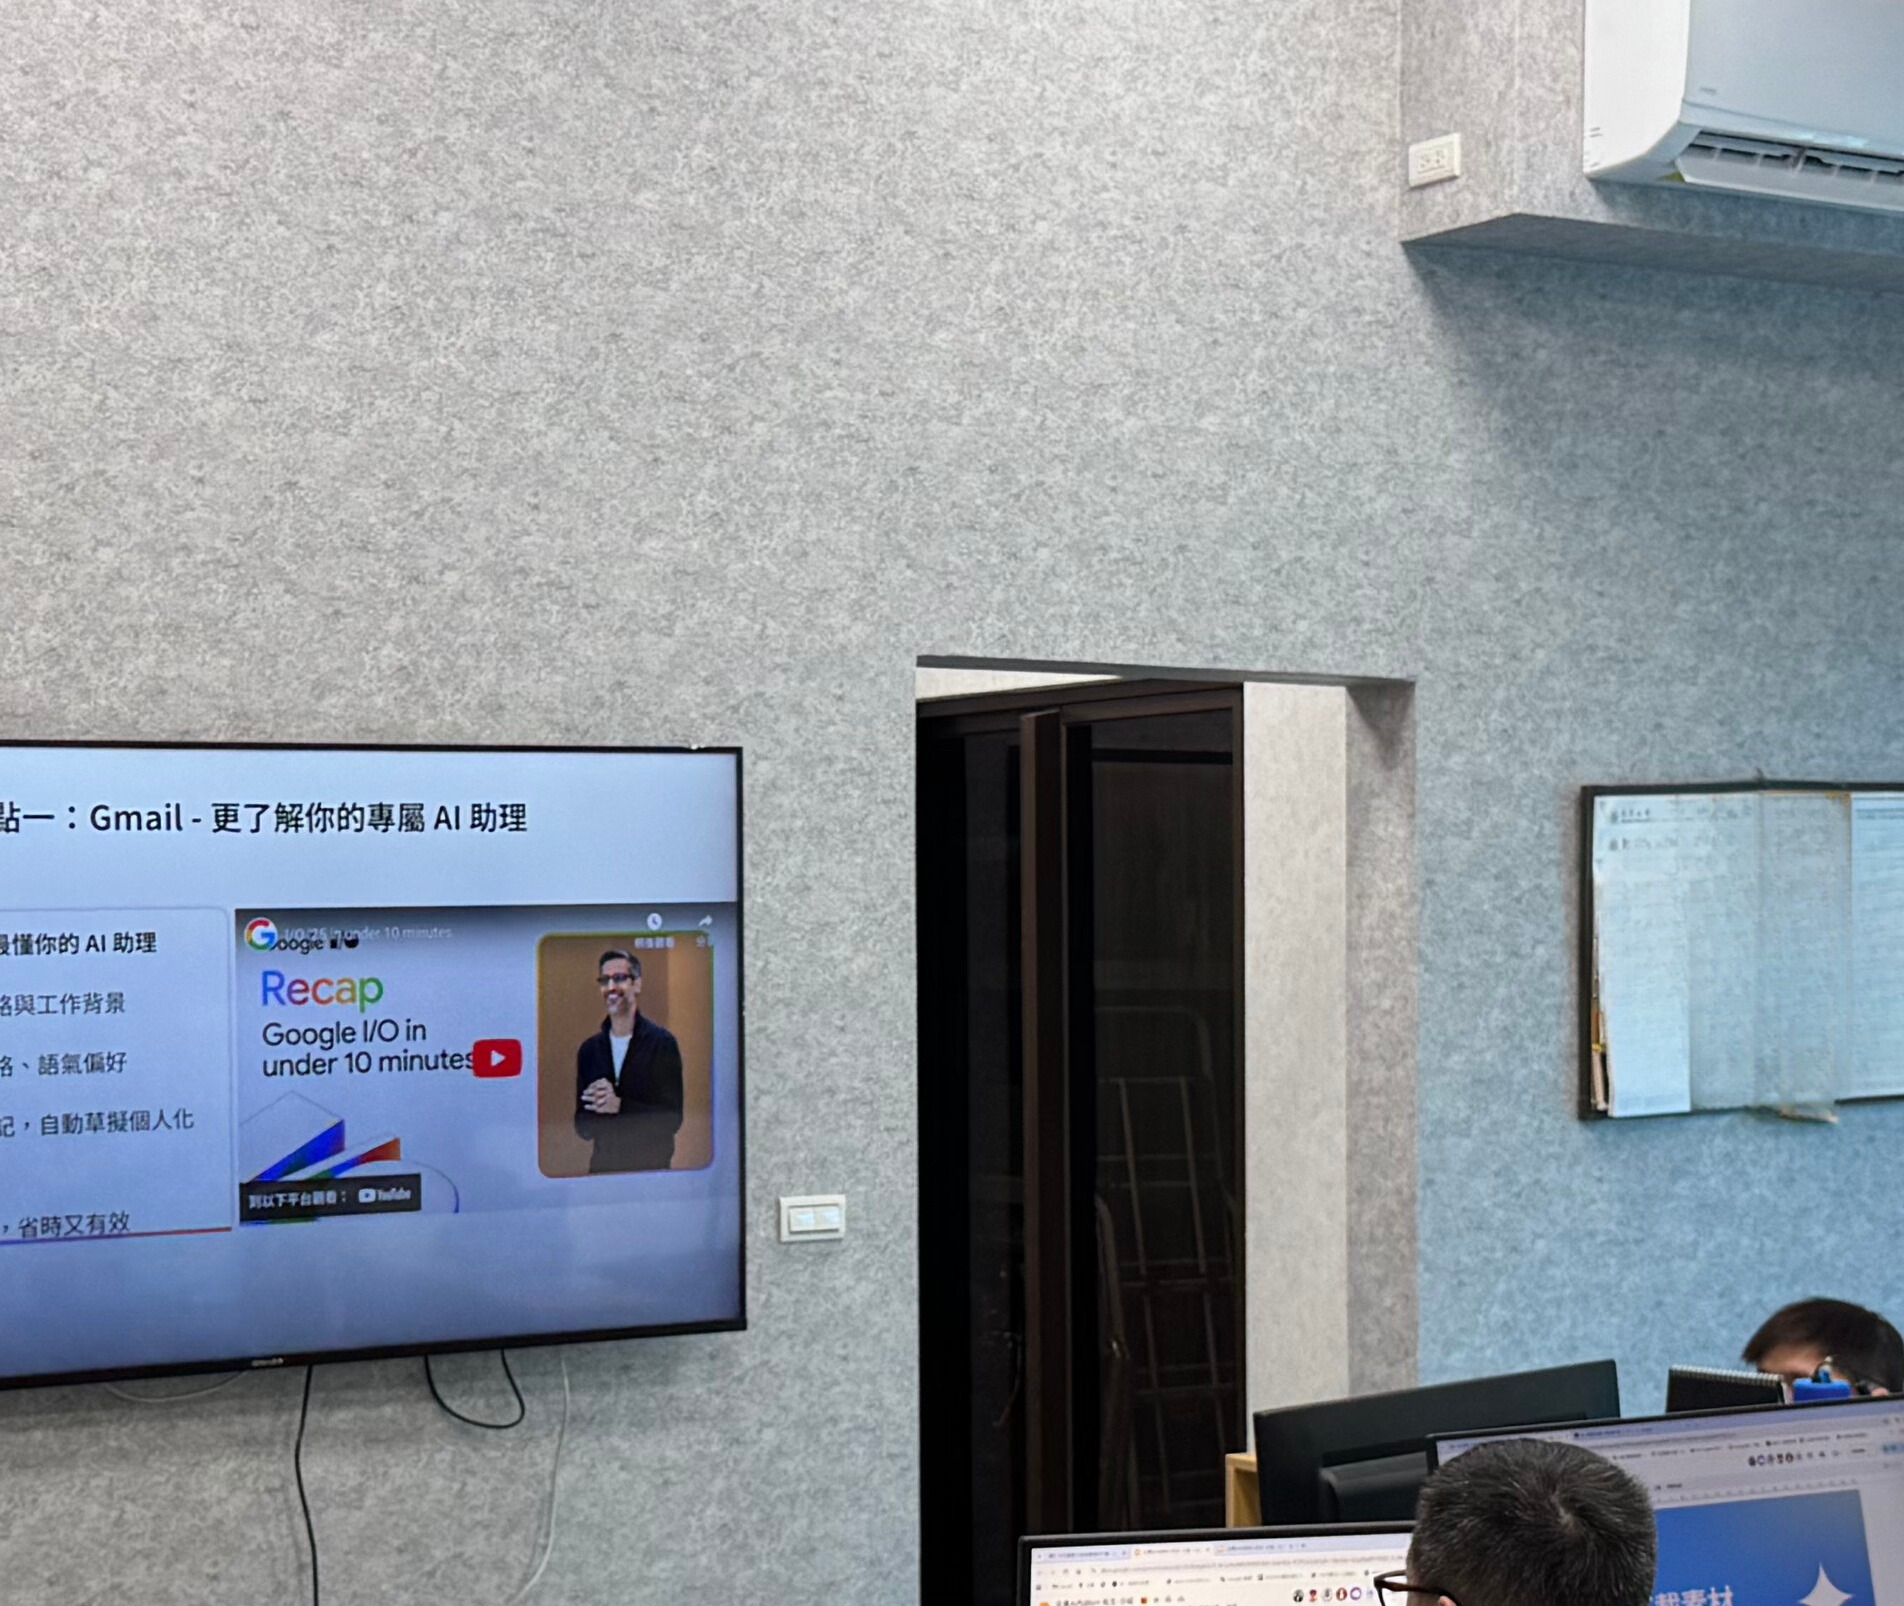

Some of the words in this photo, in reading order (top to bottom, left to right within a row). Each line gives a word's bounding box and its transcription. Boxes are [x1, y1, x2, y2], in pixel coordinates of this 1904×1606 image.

[211, 802, 425, 833] 更了解你的專屬
[433, 805, 460, 831] AI
[470, 802, 527, 833] 助理
[85, 934, 106, 953] AI
[112, 931, 158, 955] 助理
[385, 926, 400, 940] 10
[402, 925, 453, 940] minutes
[261, 969, 384, 1014] Recap
[262, 1020, 356, 1051] Google
[363, 1018, 400, 1043] I/O
[406, 1017, 427, 1042] in
[263, 1052, 338, 1077] under
[345, 1050, 372, 1073] 10
[379, 1048, 474, 1073] minutes
